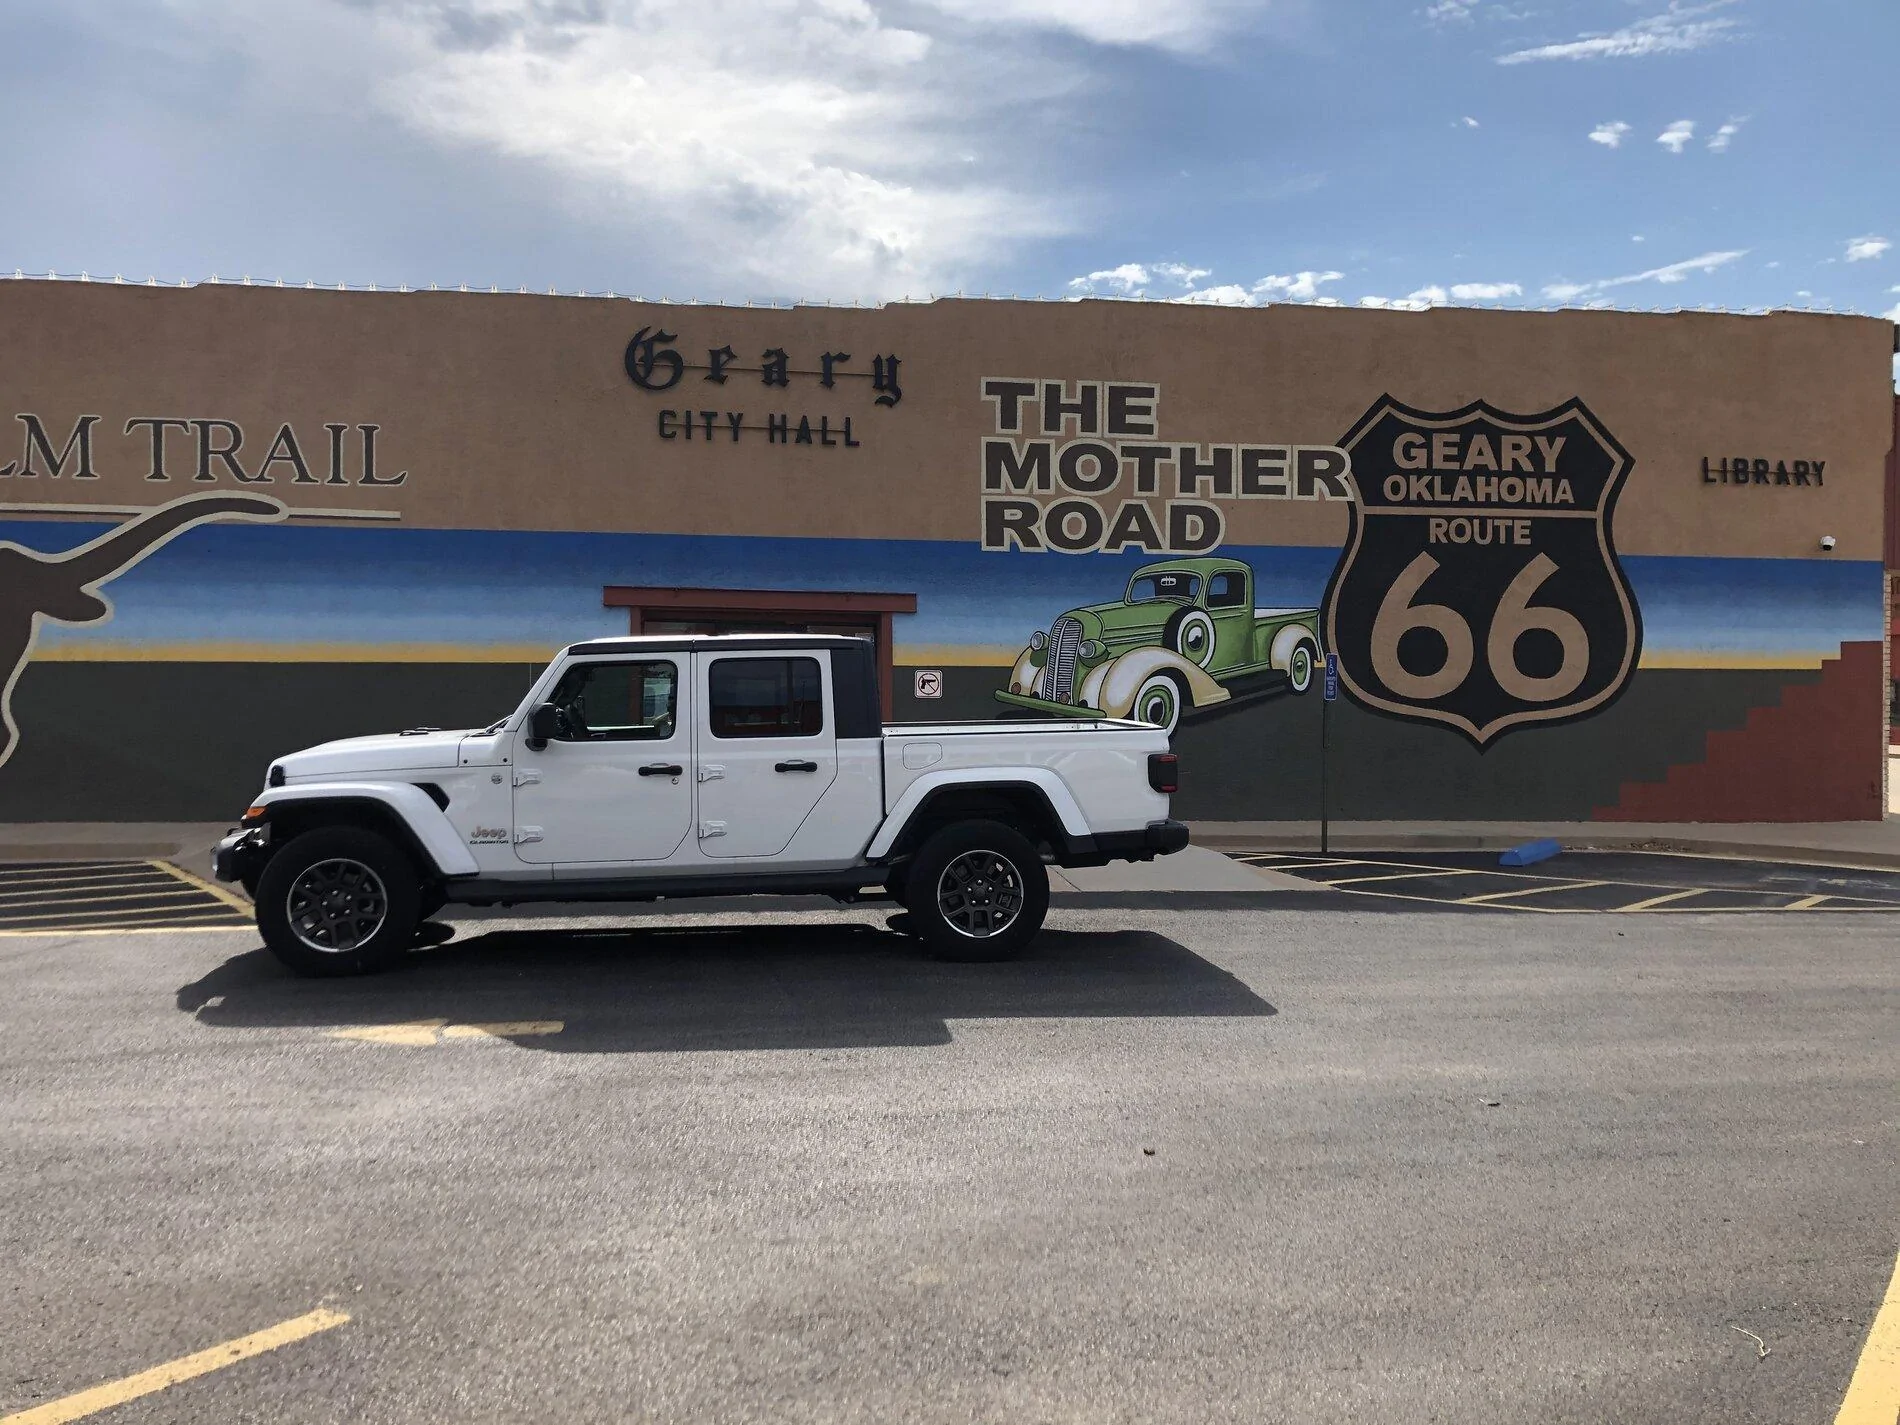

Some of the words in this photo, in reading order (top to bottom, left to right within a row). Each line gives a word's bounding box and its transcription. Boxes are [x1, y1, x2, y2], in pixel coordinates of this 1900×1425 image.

[624, 326, 903, 407] Geary
[658, 409, 744, 442] CITY
[769, 414, 861, 447] HALL
[980, 376, 1160, 440] THE
[123, 416, 408, 487] TRAIL
[980, 437, 1355, 502] MOTHER
[1392, 432, 1567, 474] GEARY
[1702, 455, 1827, 487] LIBRARY
[1382, 474, 1576, 505] OKLAHOMA
[980, 495, 1226, 555] ROAD
[1428, 516, 1532, 546] ROUTE
[1370, 551, 1590, 703] 66
[470, 826, 507, 839] Jeep
